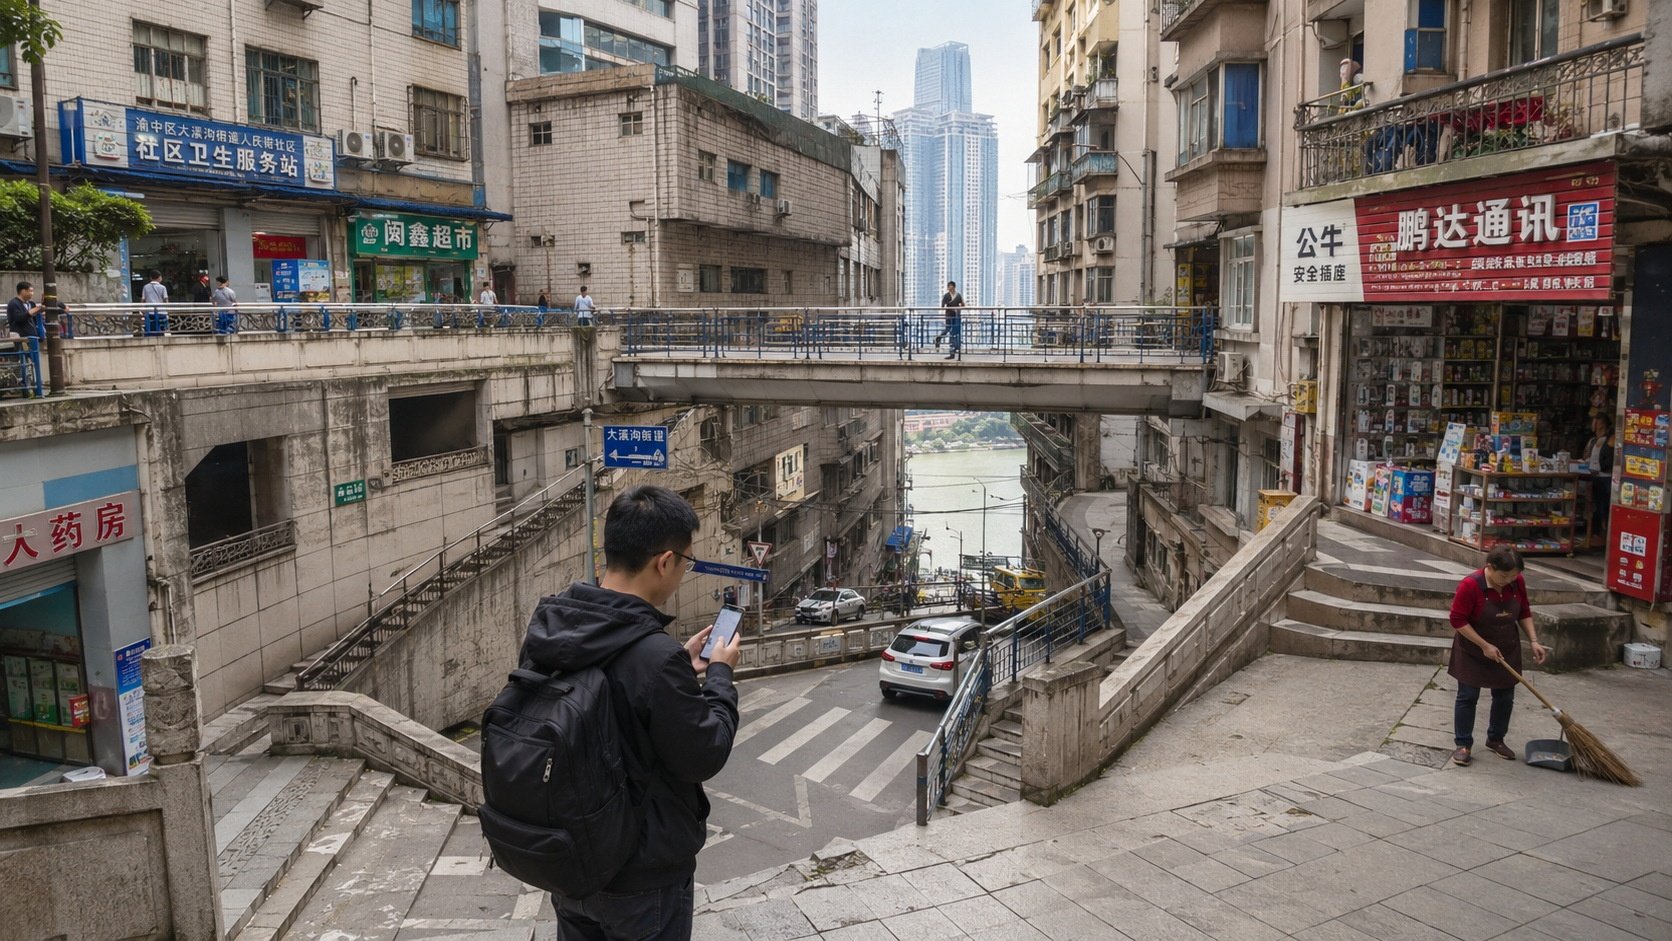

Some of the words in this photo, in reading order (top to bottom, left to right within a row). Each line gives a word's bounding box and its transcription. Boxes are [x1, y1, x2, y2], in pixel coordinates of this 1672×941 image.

[135, 134, 298, 178] 社区卫生服务站
[1296, 224, 1344, 259] 公牛
[1397, 194, 1561, 251] 鹏达通讯
[1293, 264, 1347, 283] 安全插座
